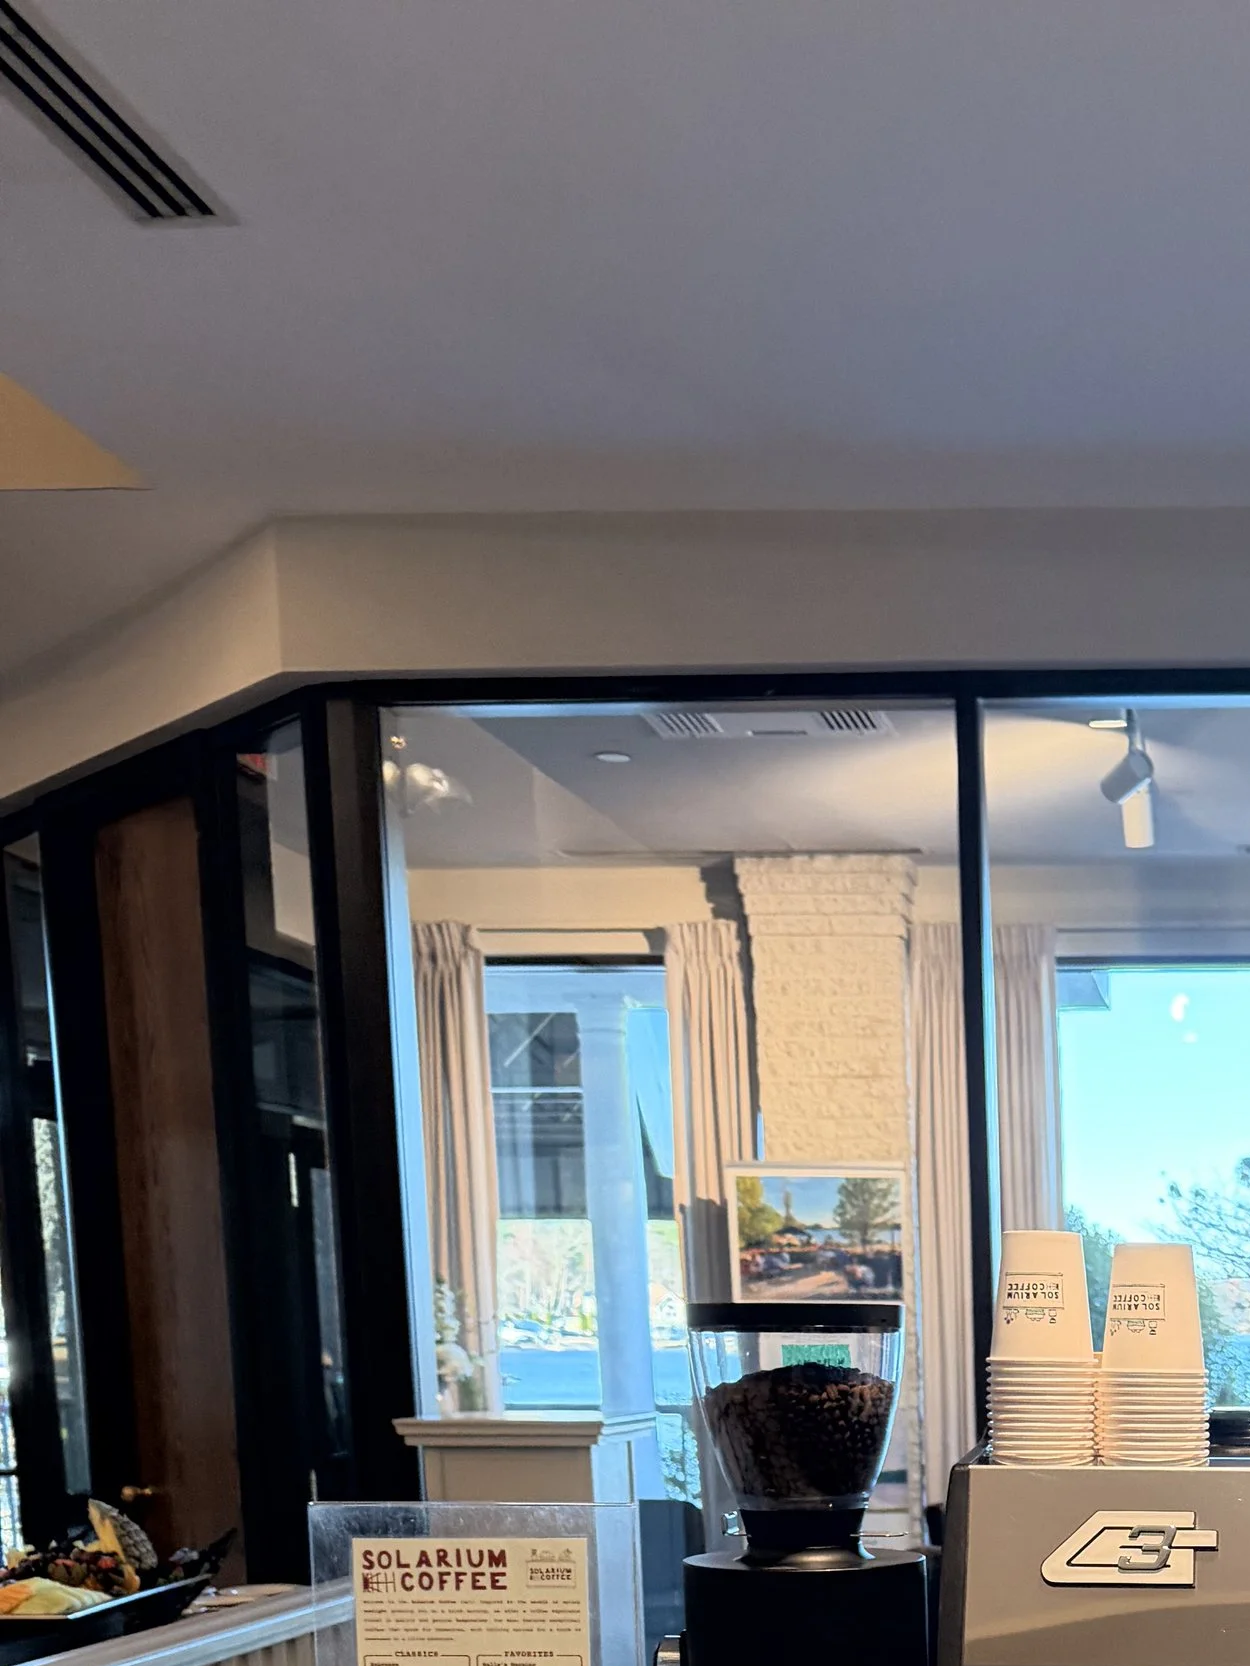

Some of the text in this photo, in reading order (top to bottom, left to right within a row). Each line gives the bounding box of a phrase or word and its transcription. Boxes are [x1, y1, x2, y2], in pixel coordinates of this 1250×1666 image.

[1007, 1282, 1045, 1291] COFFEE
[1006, 1291, 1060, 1300] SOLARIUM
[362, 1548, 507, 1570] SOLARIUM
[400, 1572, 508, 1592] COFFEE
